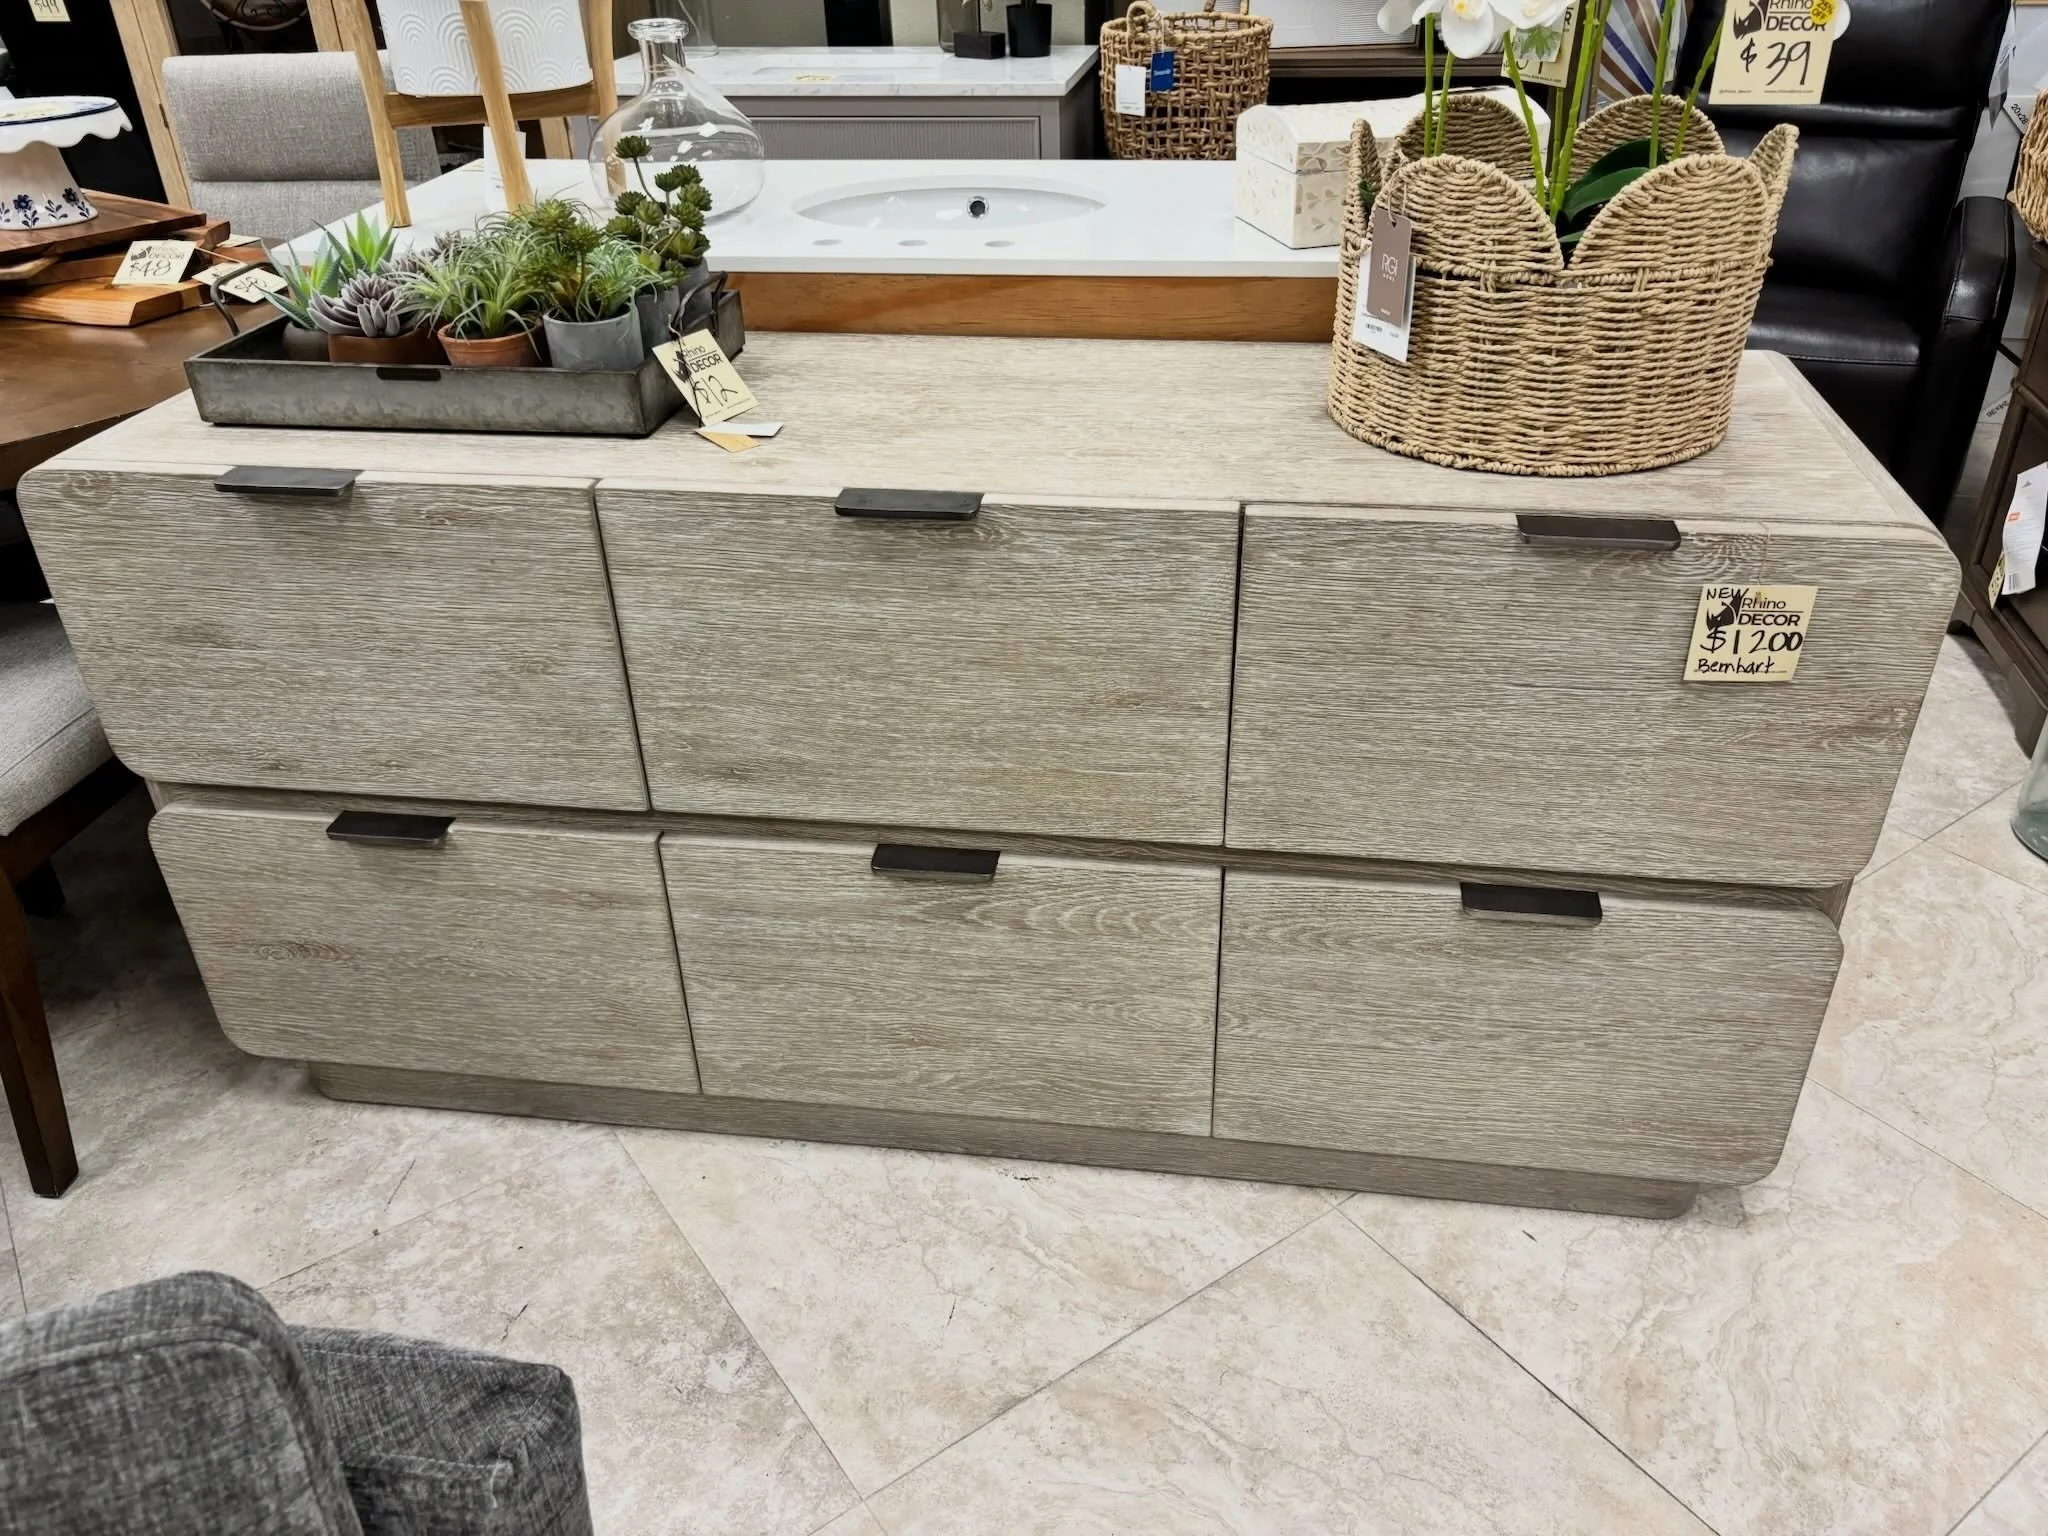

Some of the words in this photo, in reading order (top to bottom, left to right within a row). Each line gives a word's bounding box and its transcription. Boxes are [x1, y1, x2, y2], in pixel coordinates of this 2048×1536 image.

[1768, 0, 1813, 10] Rhino
[682, 345, 706, 358] Rhino
[690, 353, 724, 373] DECOR
[1706, 587, 1749, 601] NEW
[1741, 597, 1786, 610] Rhino
[1737, 613, 1801, 626] DECOR
[1699, 625, 1804, 655] $1200
